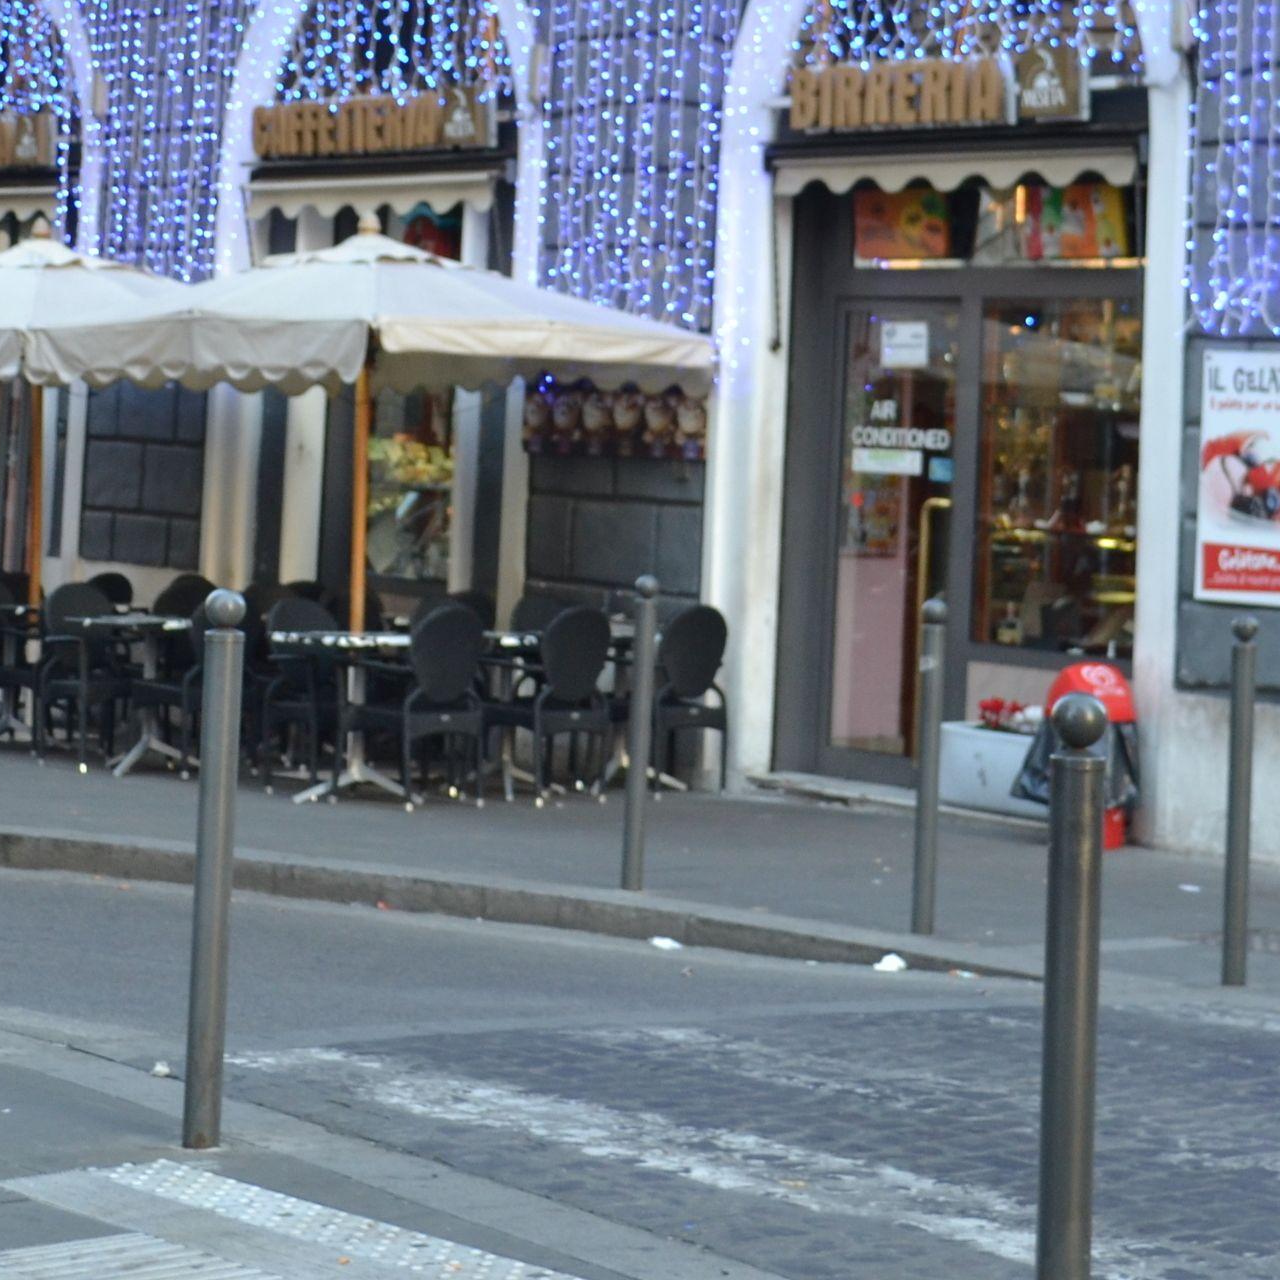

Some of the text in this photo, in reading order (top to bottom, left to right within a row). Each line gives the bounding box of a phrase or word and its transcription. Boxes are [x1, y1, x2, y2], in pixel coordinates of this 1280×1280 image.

[790, 60, 1004, 132] BIRRERIA
[1208, 366, 1226, 392] IL
[870, 399, 898, 421] AIR
[851, 424, 952, 451] CONDITIONED
